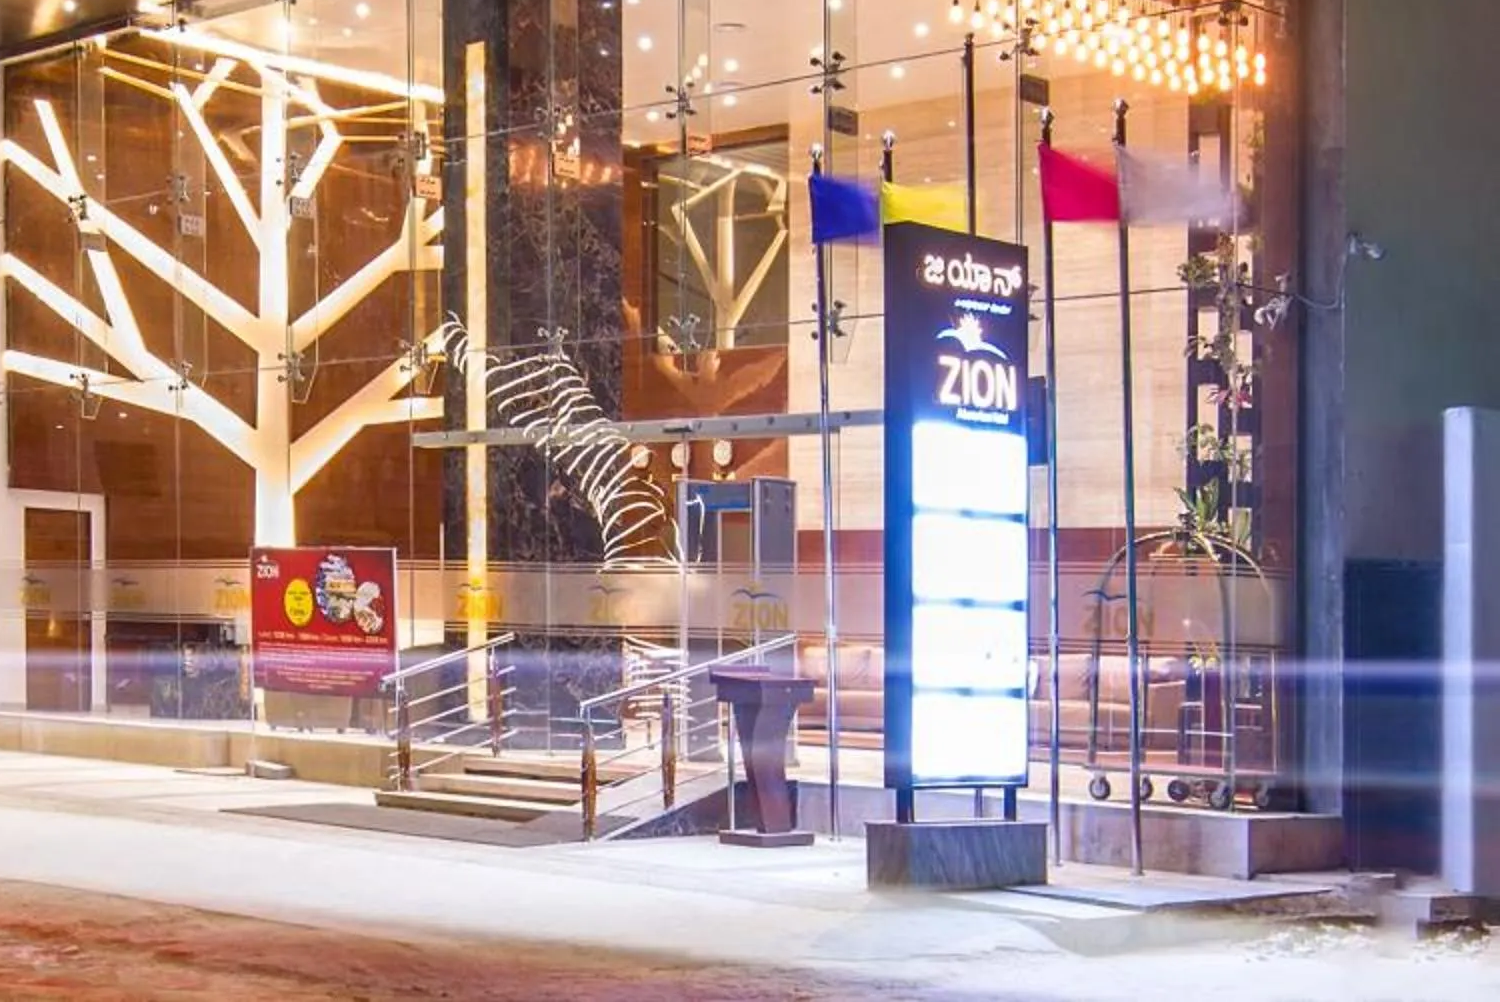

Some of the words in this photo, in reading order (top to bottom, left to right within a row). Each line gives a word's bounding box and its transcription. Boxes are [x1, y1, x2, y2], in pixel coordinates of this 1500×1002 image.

[938, 355, 1017, 412] ZION
[732, 601, 788, 629] ZION
[1083, 604, 1155, 637] ZION
